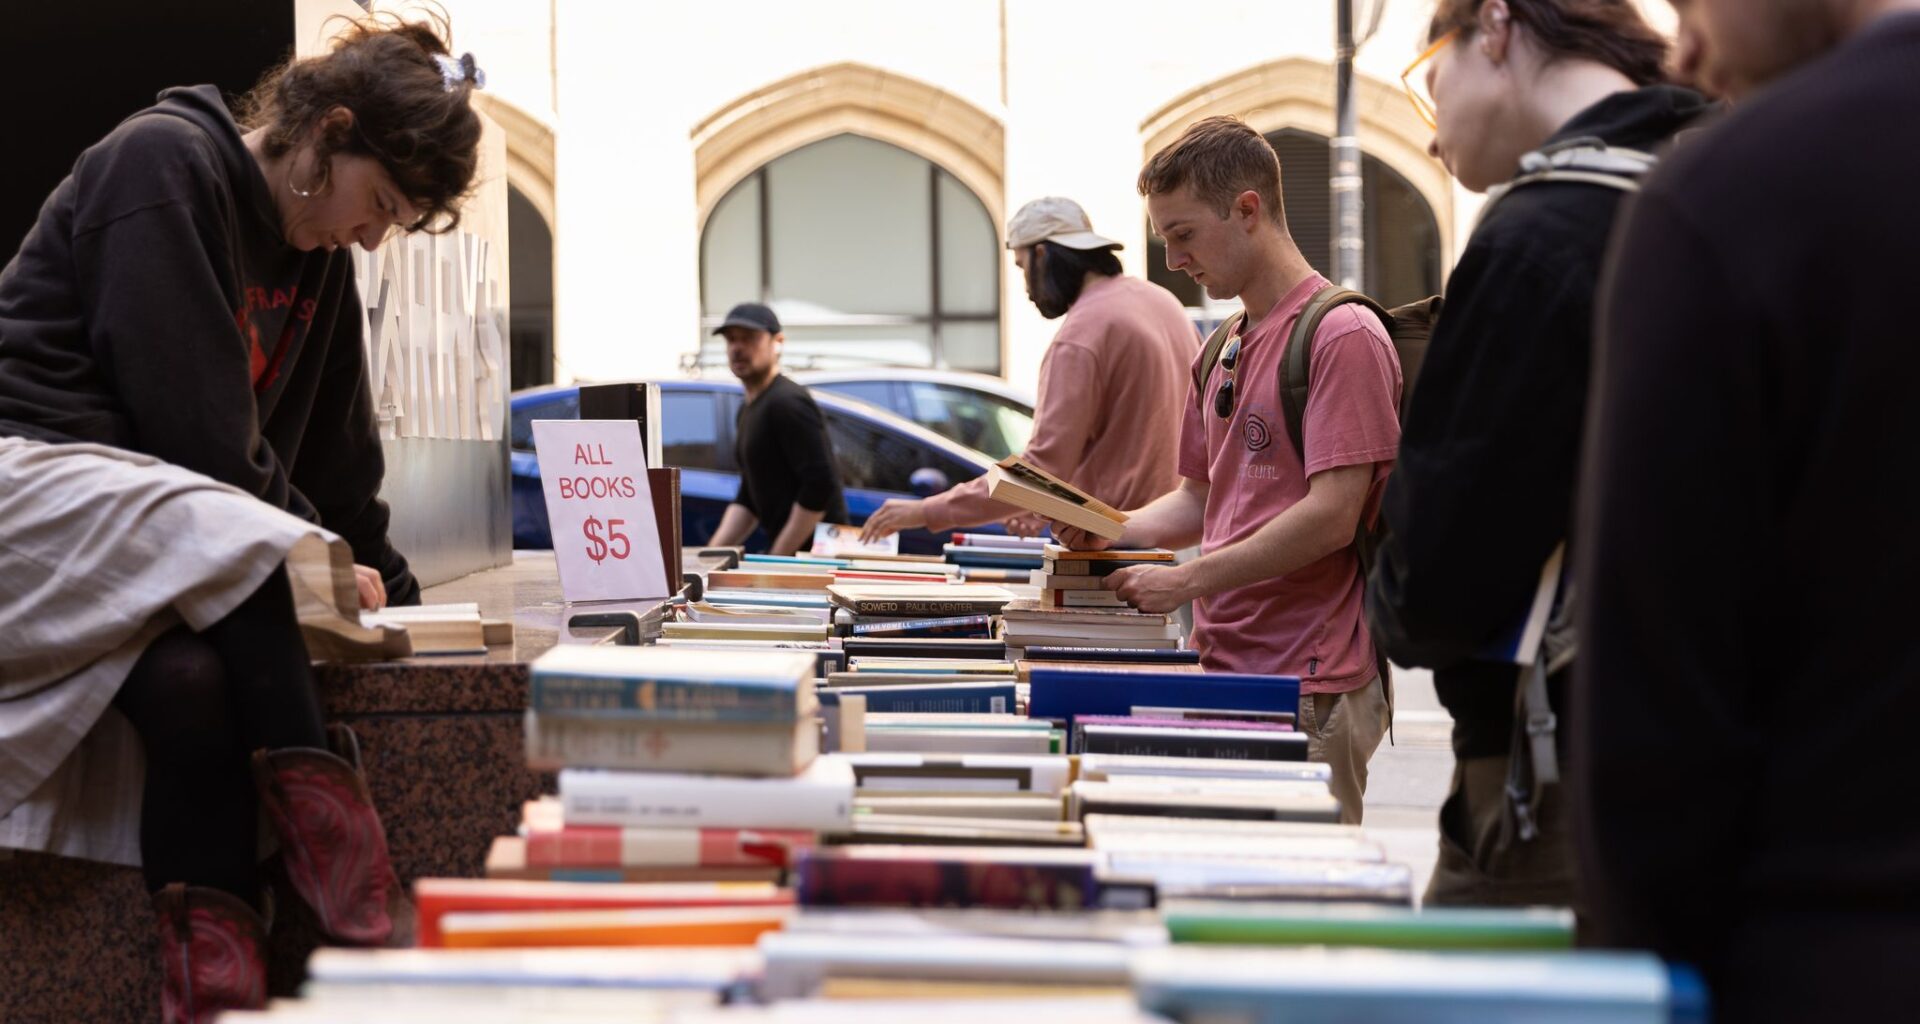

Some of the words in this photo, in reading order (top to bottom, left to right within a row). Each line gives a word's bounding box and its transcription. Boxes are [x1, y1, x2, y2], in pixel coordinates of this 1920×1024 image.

[574, 443, 613, 465] ALL
[1248, 464, 1280, 480] CURL
[559, 476, 636, 499] BOOKS
[583, 514, 631, 566] $5
[860, 602, 898, 612] SOWETO
[905, 602, 929, 612] PAUL
[939, 602, 973, 612] VENTER
[855, 622, 882, 632] SARAH
[882, 621, 912, 631] VOWELL
